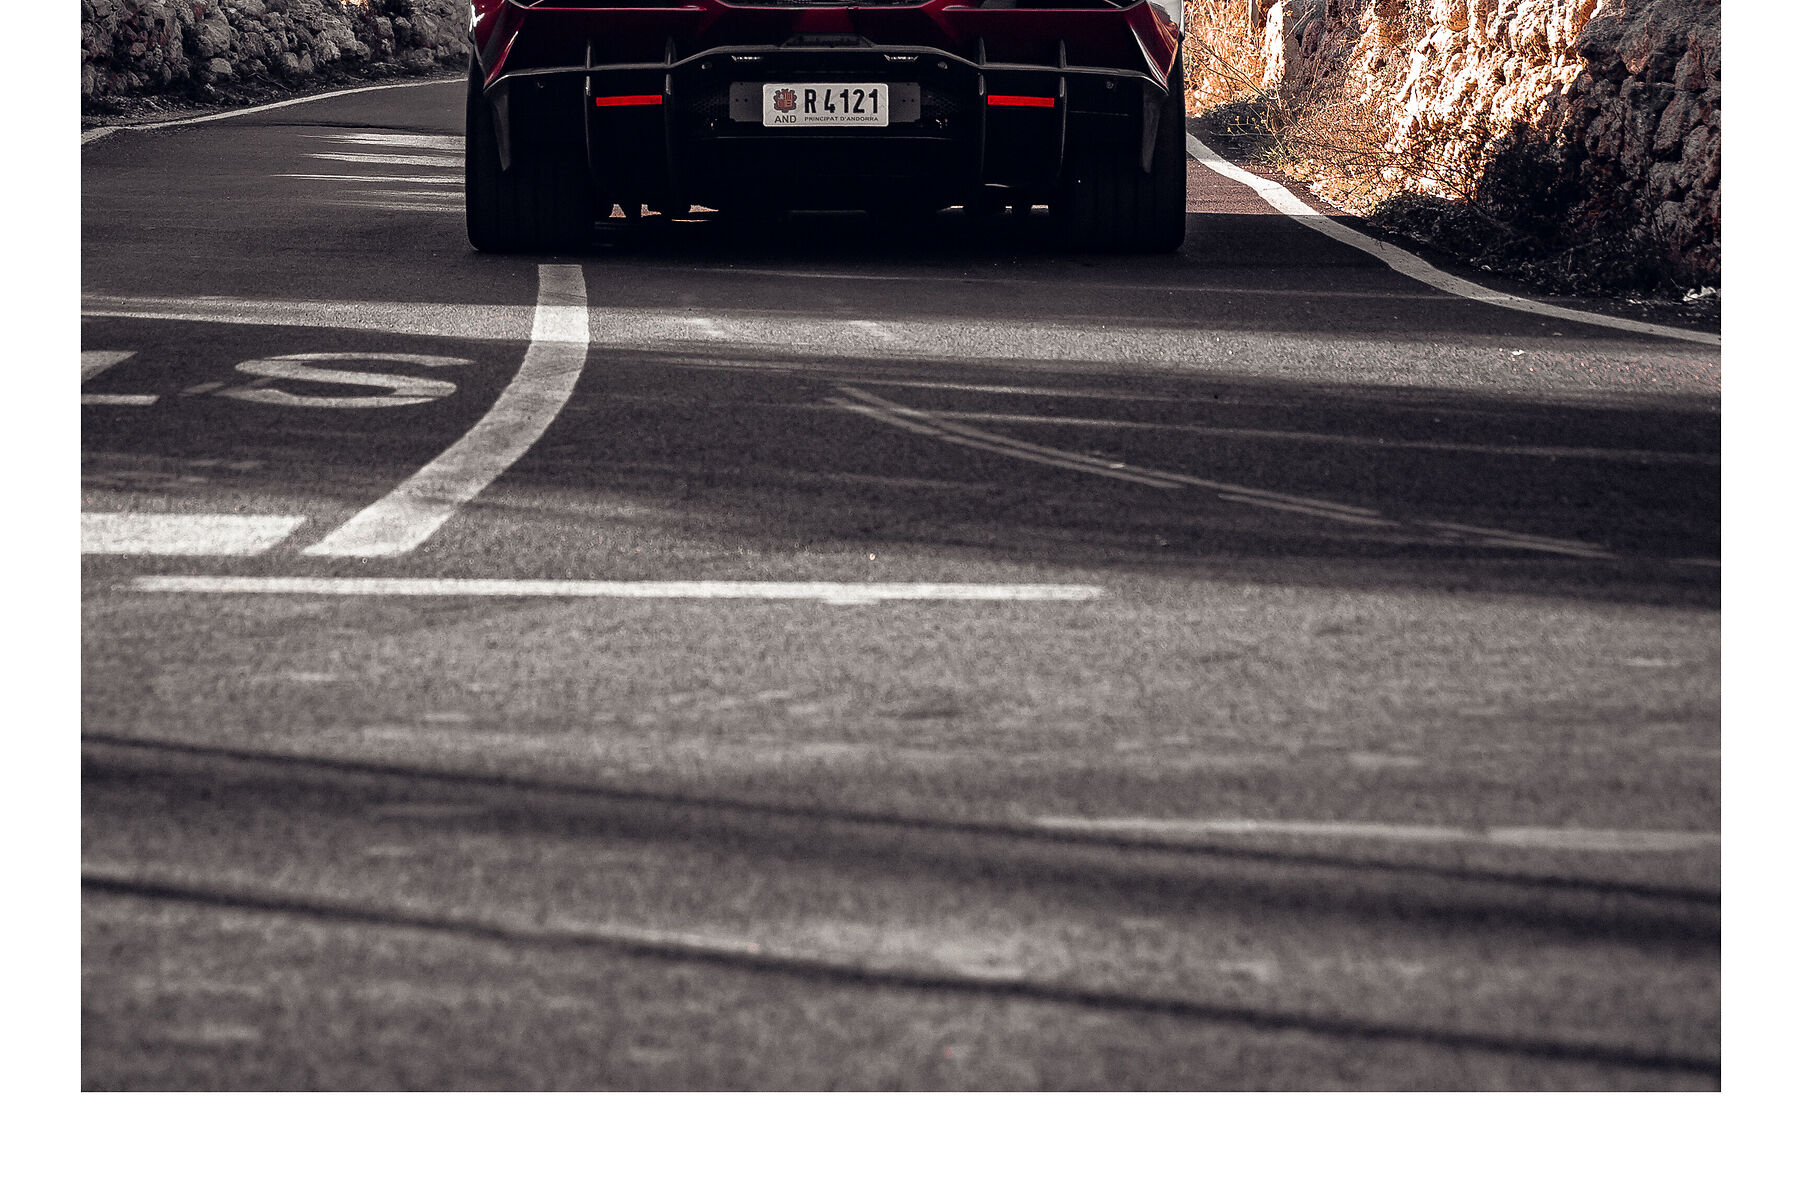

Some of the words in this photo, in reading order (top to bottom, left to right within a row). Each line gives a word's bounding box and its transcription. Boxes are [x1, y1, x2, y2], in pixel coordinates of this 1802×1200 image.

[804, 89, 817, 114] R
[824, 89, 879, 114] 4121
[774, 115, 798, 123] AND
